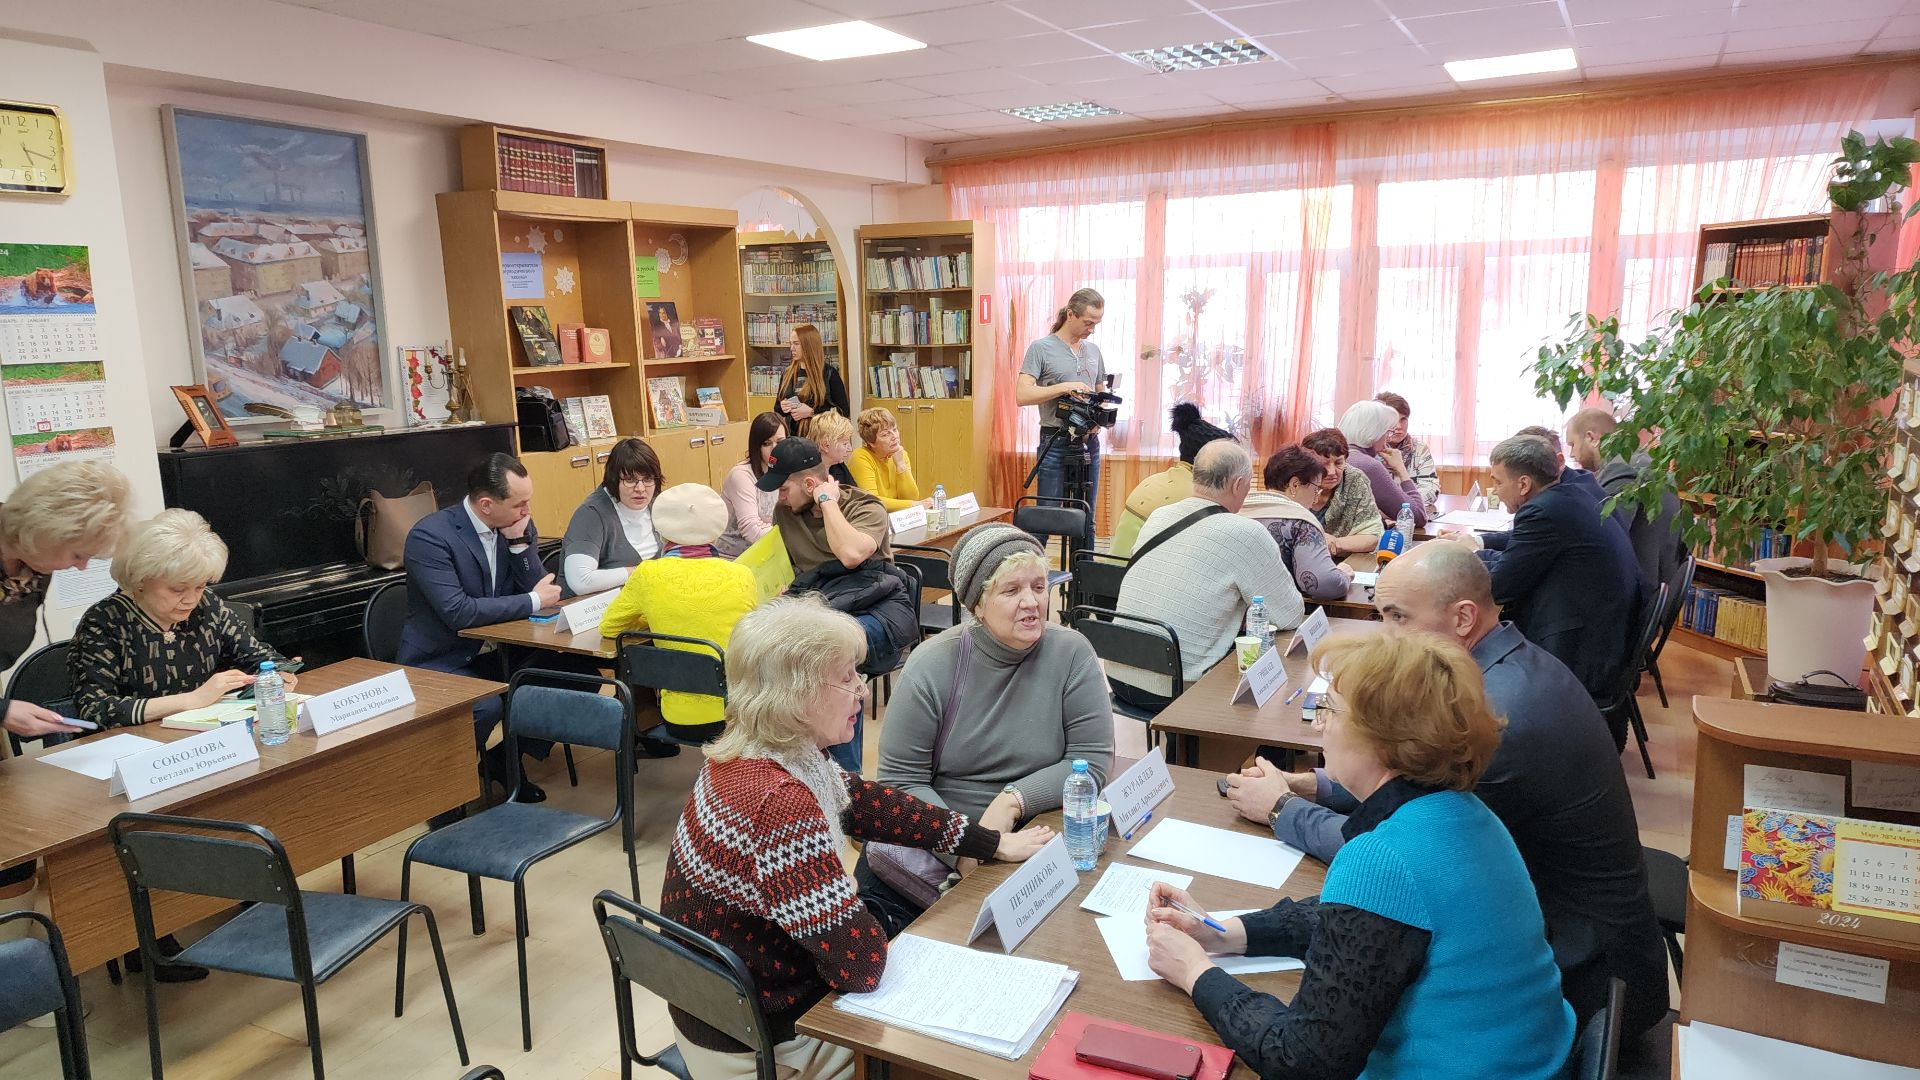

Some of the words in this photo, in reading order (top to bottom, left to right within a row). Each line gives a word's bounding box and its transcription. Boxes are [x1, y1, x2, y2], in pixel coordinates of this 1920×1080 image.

[1, 116, 11, 126] 11
[17, 116, 26, 126] 12
[35, 118, 39, 128] 1
[48, 130, 54, 140] 2
[50, 146, 56, 157] 3
[50, 163, 57, 173] 4
[9, 170, 16, 180] 7
[24, 170, 32, 182] 6
[40, 171, 48, 182] 5
[333, 686, 389, 710] КОКУНОВА
[330, 706, 367, 724] Марианна
[368, 695, 399, 712] Юрьевна
[152, 740, 226, 770] СОКОЛОВА
[150, 767, 194, 785] Светлана
[196, 752, 237, 770] Юрьевна
[1122, 766, 1154, 799] ЖУРАВЛЕВ
[1118, 803, 1140, 823] Михаил
[1140, 778, 1169, 807] Аркадьевич
[1864, 858, 1869, 866] 5
[1875, 872, 1884, 880] 13
[1888, 874, 1897, 882] 14
[1901, 876, 1910, 884] 15
[1009, 861, 1058, 911] ПЕЧНИКОВА
[1016, 909, 1034, 928] Ольга
[1033, 880, 1064, 910] Викторовна
[1817, 912, 1861, 929] 2024
